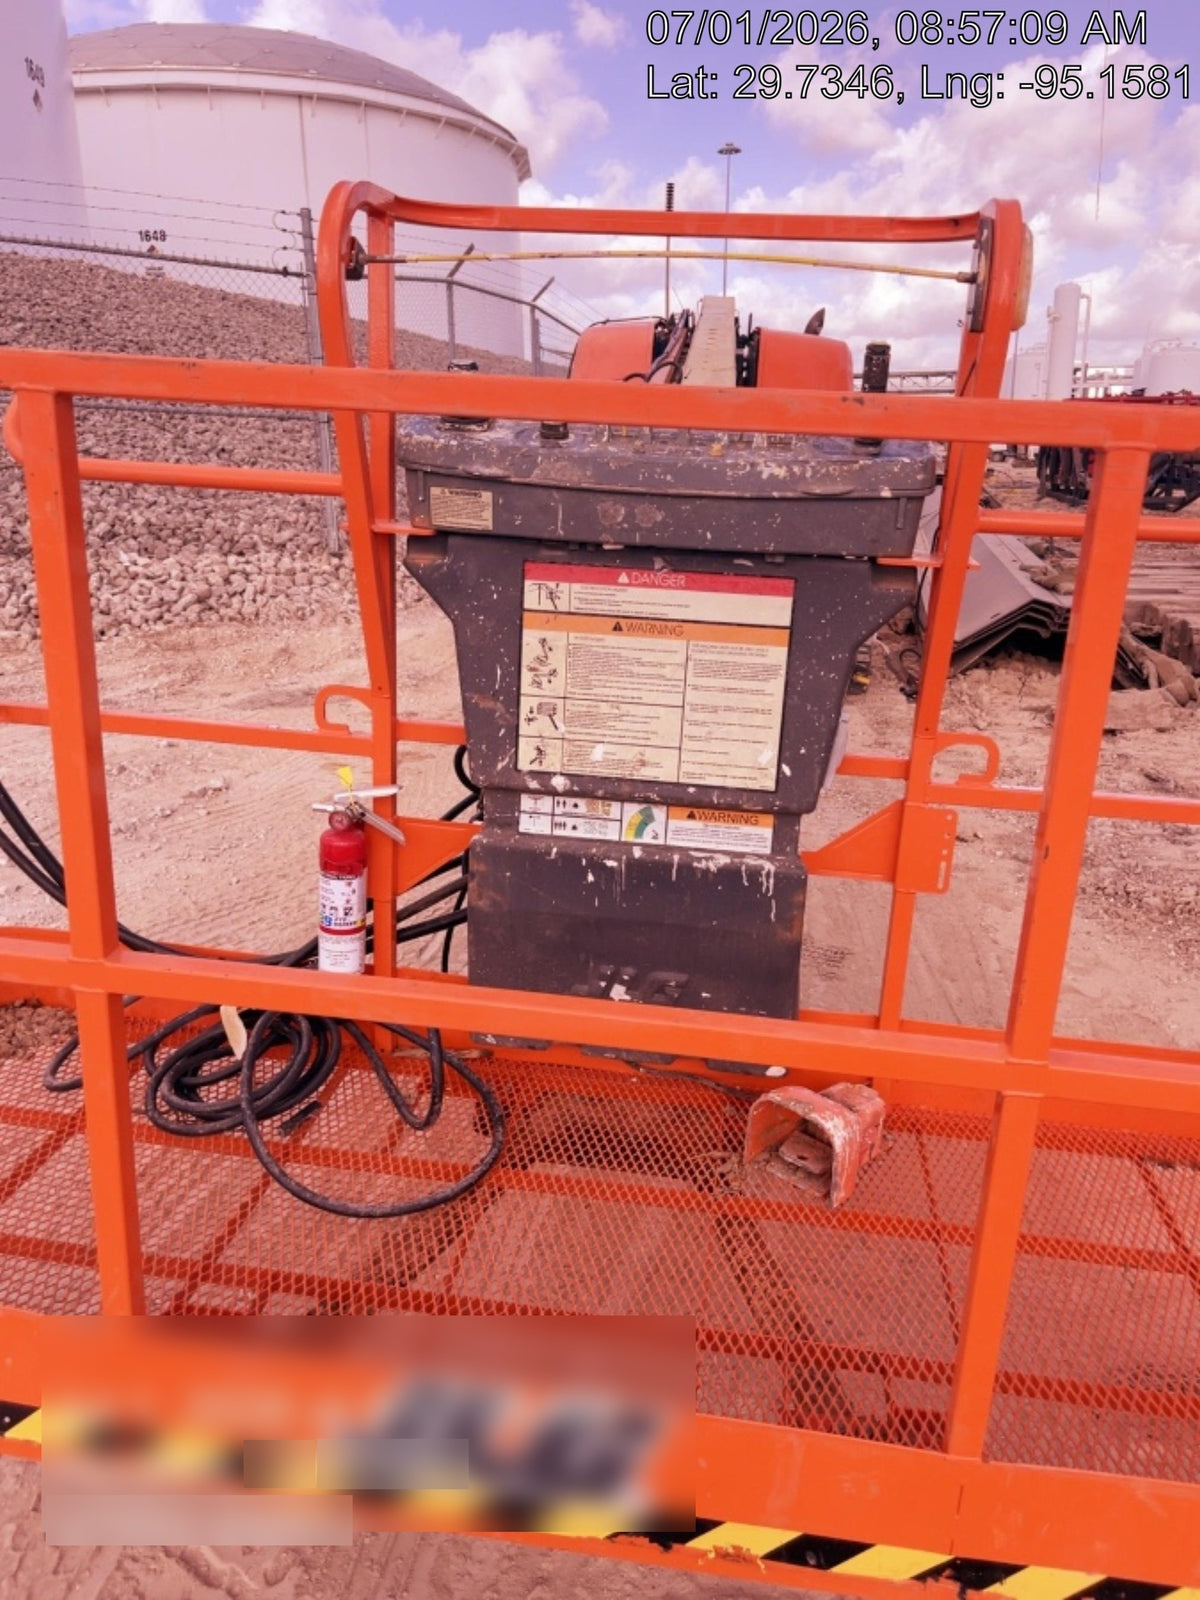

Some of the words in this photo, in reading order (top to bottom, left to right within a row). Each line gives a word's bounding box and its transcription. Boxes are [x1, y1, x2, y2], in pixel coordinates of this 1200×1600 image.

[139, 229, 167, 242] 1648
[631, 572, 686, 587] DANGER
[625, 621, 684, 637] WARNING
[697, 810, 759, 825] WARNING
